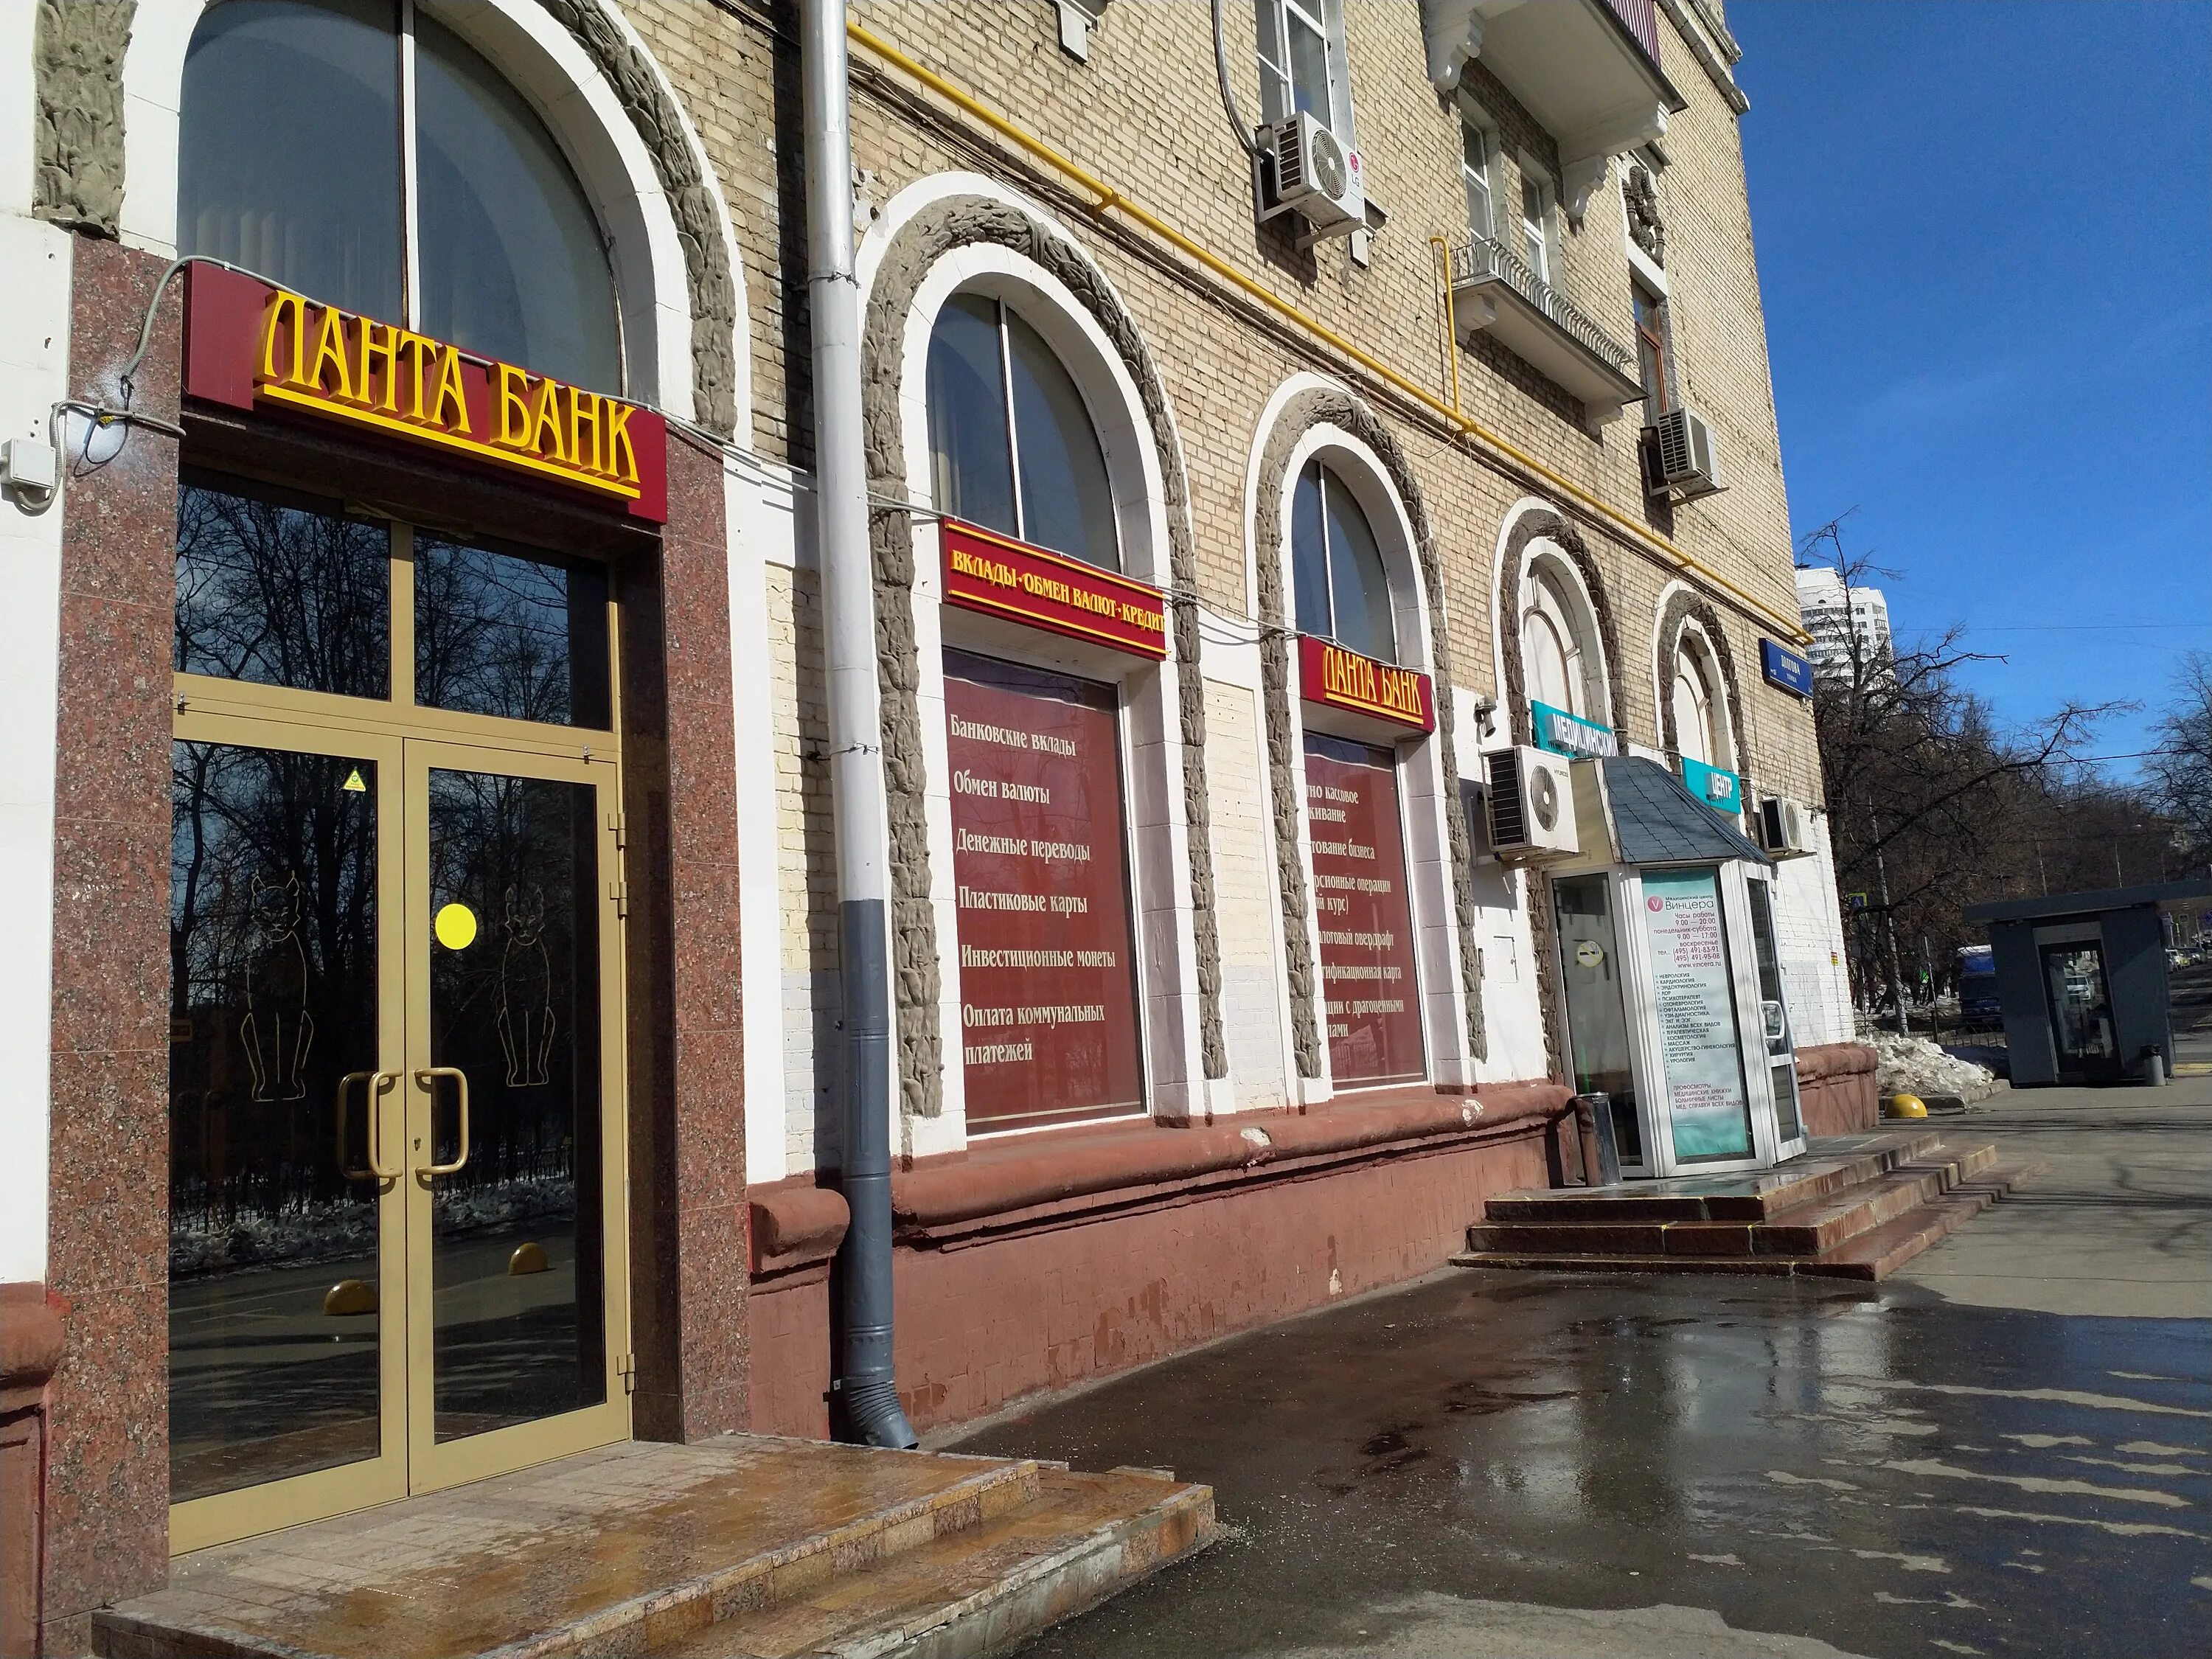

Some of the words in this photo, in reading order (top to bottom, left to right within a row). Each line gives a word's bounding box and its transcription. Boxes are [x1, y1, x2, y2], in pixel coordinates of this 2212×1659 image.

[1351, 173, 1360, 187] LG
[495, 362, 641, 484] БАНК
[951, 549, 1018, 589] ВКЛАДЫ
[1023, 572, 1070, 605] ОБМЕН
[1071, 587, 1116, 619] ВАЛЮТ
[1381, 667, 1423, 715] БАНК
[950, 713, 1028, 749] Банковские
[1031, 733, 1077, 760] вклады
[1552, 713, 1618, 757] МЕДИЦИНСКИЙ
[953, 768, 998, 799] Обмен
[1001, 782, 1050, 804] валюты
[1325, 786, 1359, 804] кассовое
[1711, 771, 1733, 799] ЦЕНТР
[956, 828, 1028, 857] Денежные
[1031, 839, 1091, 864] переводы
[1348, 838, 1376, 860] бизнеса
[1357, 877, 1391, 897] операции
[959, 886, 1046, 912] Пластиковые
[1050, 895, 1088, 919] карты
[1327, 895, 1349, 916] курс)
[1665, 900, 1714, 911] Винцера
[1693, 911, 1715, 919] работы
[1653, 925, 1717, 934] понедельник-суббота
[1354, 930, 1394, 951] овердрафт
[1680, 939, 1719, 948] воскресенье
[961, 945, 1074, 972] Инвестиционные
[1077, 950, 1116, 967] монеты
[1672, 947, 1688, 956] (495)
[1674, 954, 1689, 963] (495)
[1382, 967, 1402, 984] карта
[1677, 961, 1722, 969] www.vincera.ru
[963, 1004, 1014, 1028] Оплата
[1017, 1004, 1105, 1030] коммунальных
[1346, 1001, 1351, 1015] с
[1352, 999, 1405, 1019] драгоценными
[1663, 1005, 1706, 1013] ОФТАЛЬМОЛОГИЯ
[964, 1037, 1033, 1065] платежей
